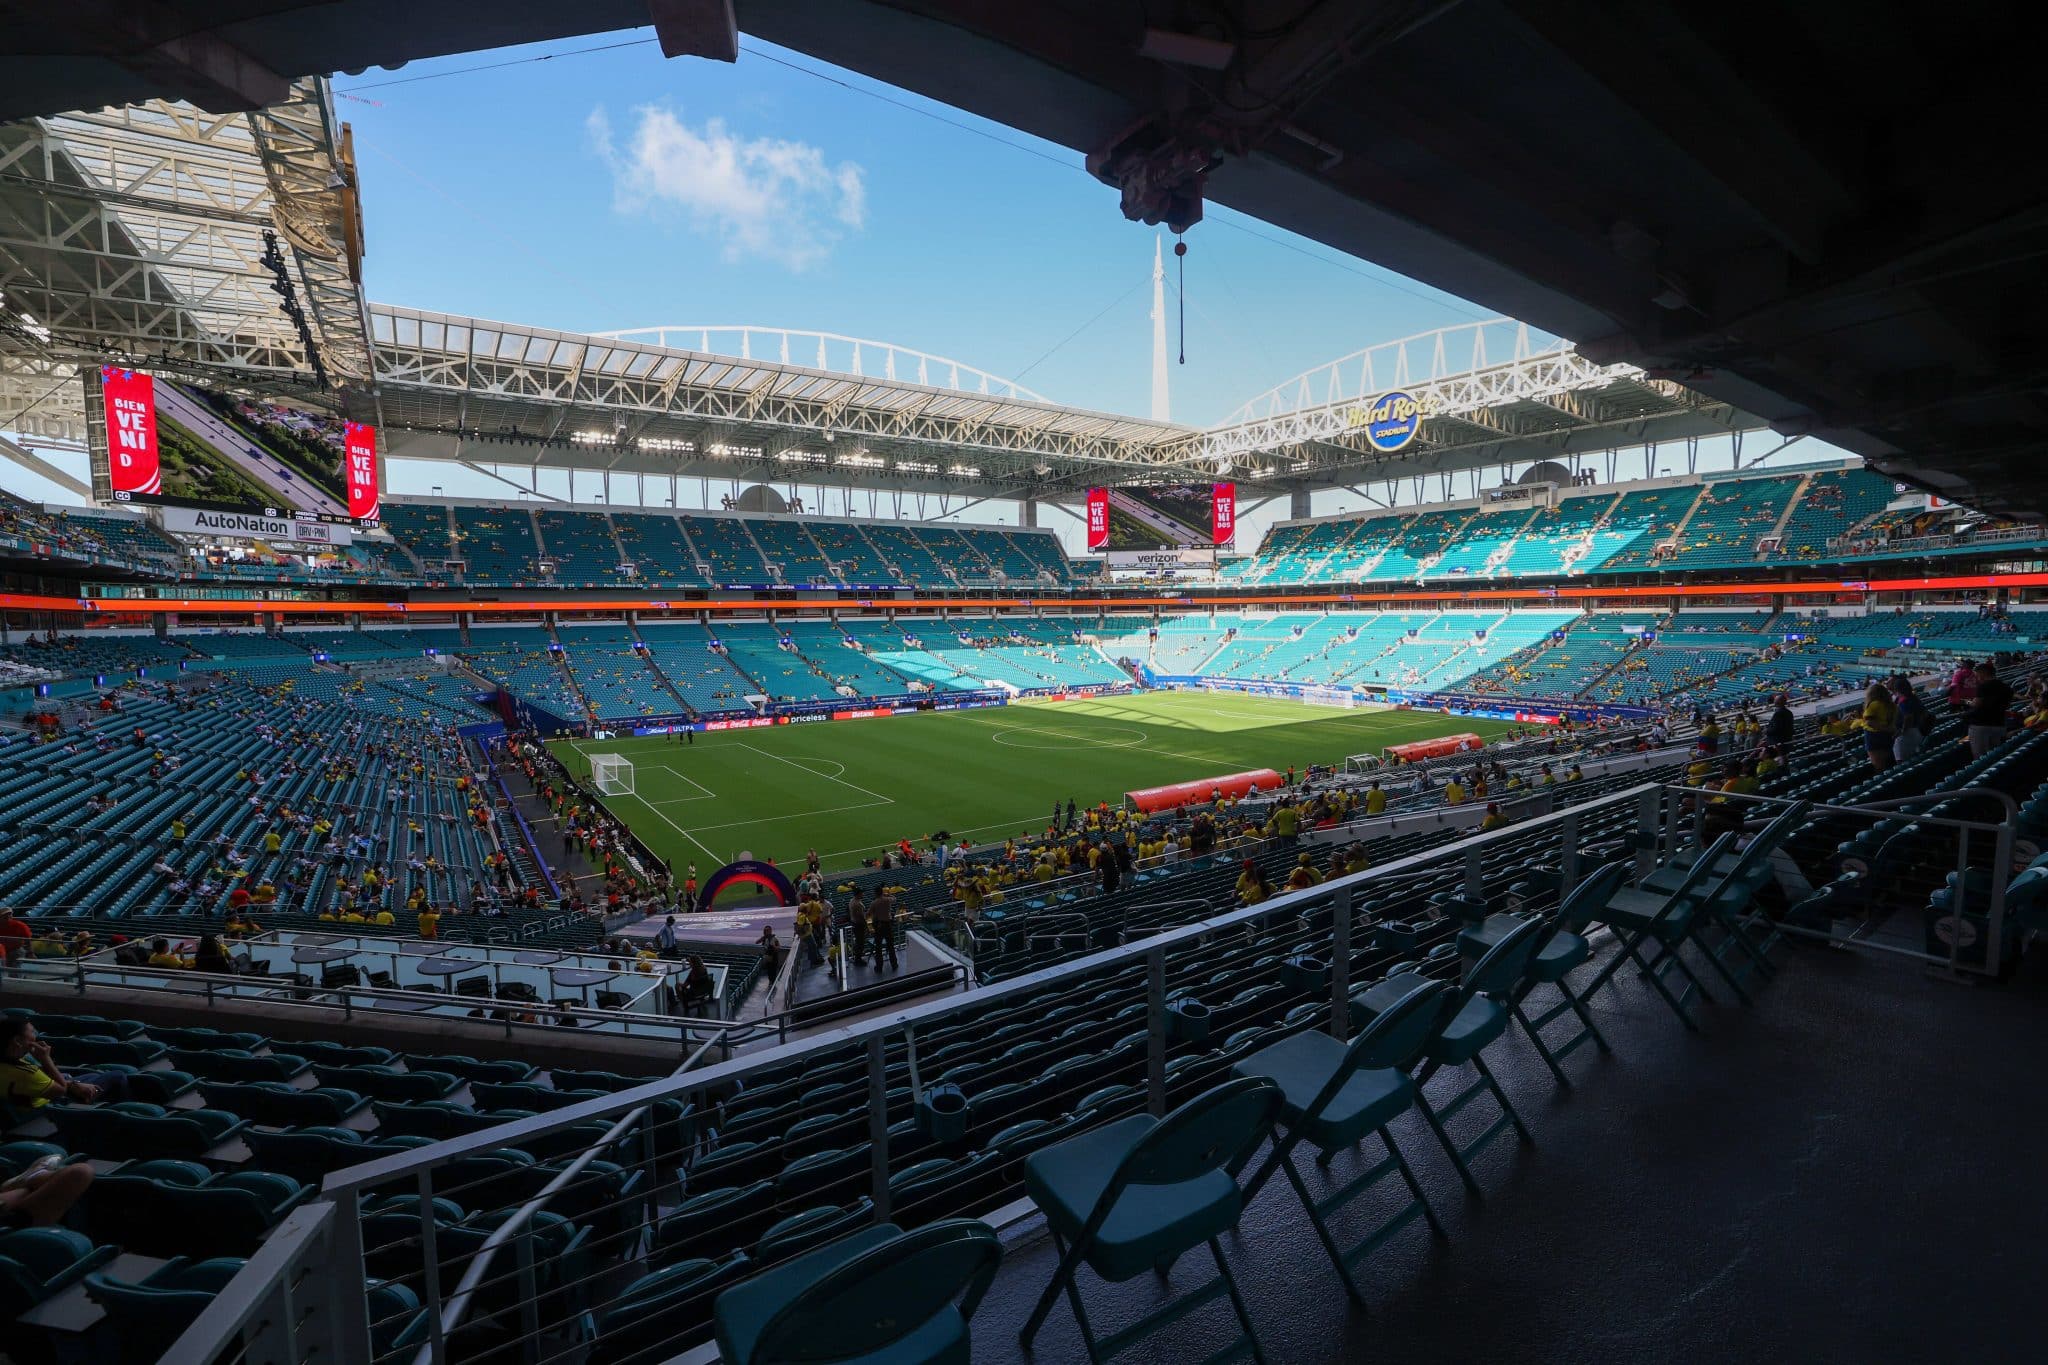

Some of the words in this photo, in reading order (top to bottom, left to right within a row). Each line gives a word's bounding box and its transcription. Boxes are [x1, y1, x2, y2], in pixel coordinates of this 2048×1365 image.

[114, 398, 146, 413] BIEN
[1347, 400, 1393, 428] Hard
[1392, 397, 1439, 423] Rock
[116, 410, 147, 431] VE
[1375, 426, 1410, 438] STADIUM
[119, 430, 147, 450] NI
[351, 445, 371, 456] BIEN
[120, 453, 133, 467] D
[352, 454, 371, 471] VE
[354, 470, 371, 486] NI
[117, 491, 129, 500] CC
[1091, 507, 1104, 516] VE
[1217, 503, 1231, 513] VE
[195, 512, 288, 534] AutoNation
[1137, 552, 1178, 562] verizon
[790, 714, 826, 724] priceless
